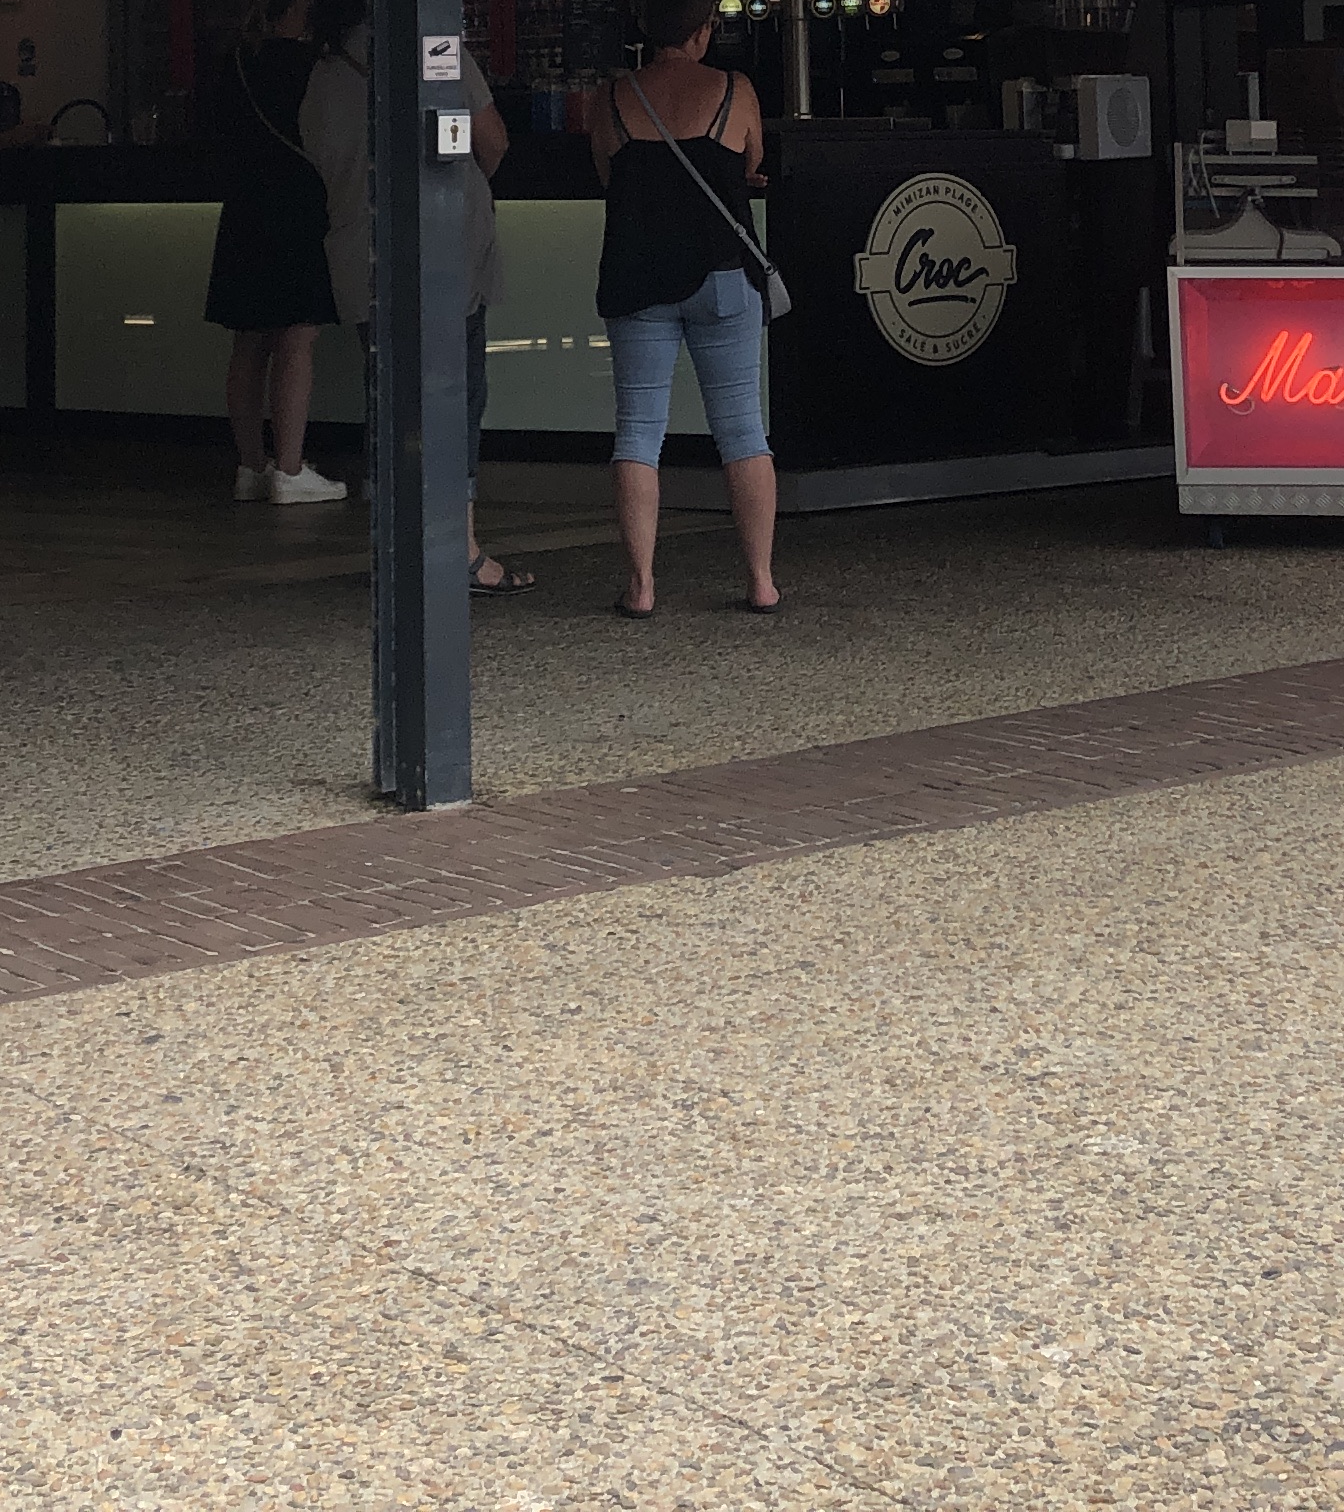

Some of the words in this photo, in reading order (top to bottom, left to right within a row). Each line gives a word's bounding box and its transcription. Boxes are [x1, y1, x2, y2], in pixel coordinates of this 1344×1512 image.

[893, 186, 940, 218] MIMIZAN
[944, 186, 980, 215] PLAGE
[894, 228, 990, 294] Croc
